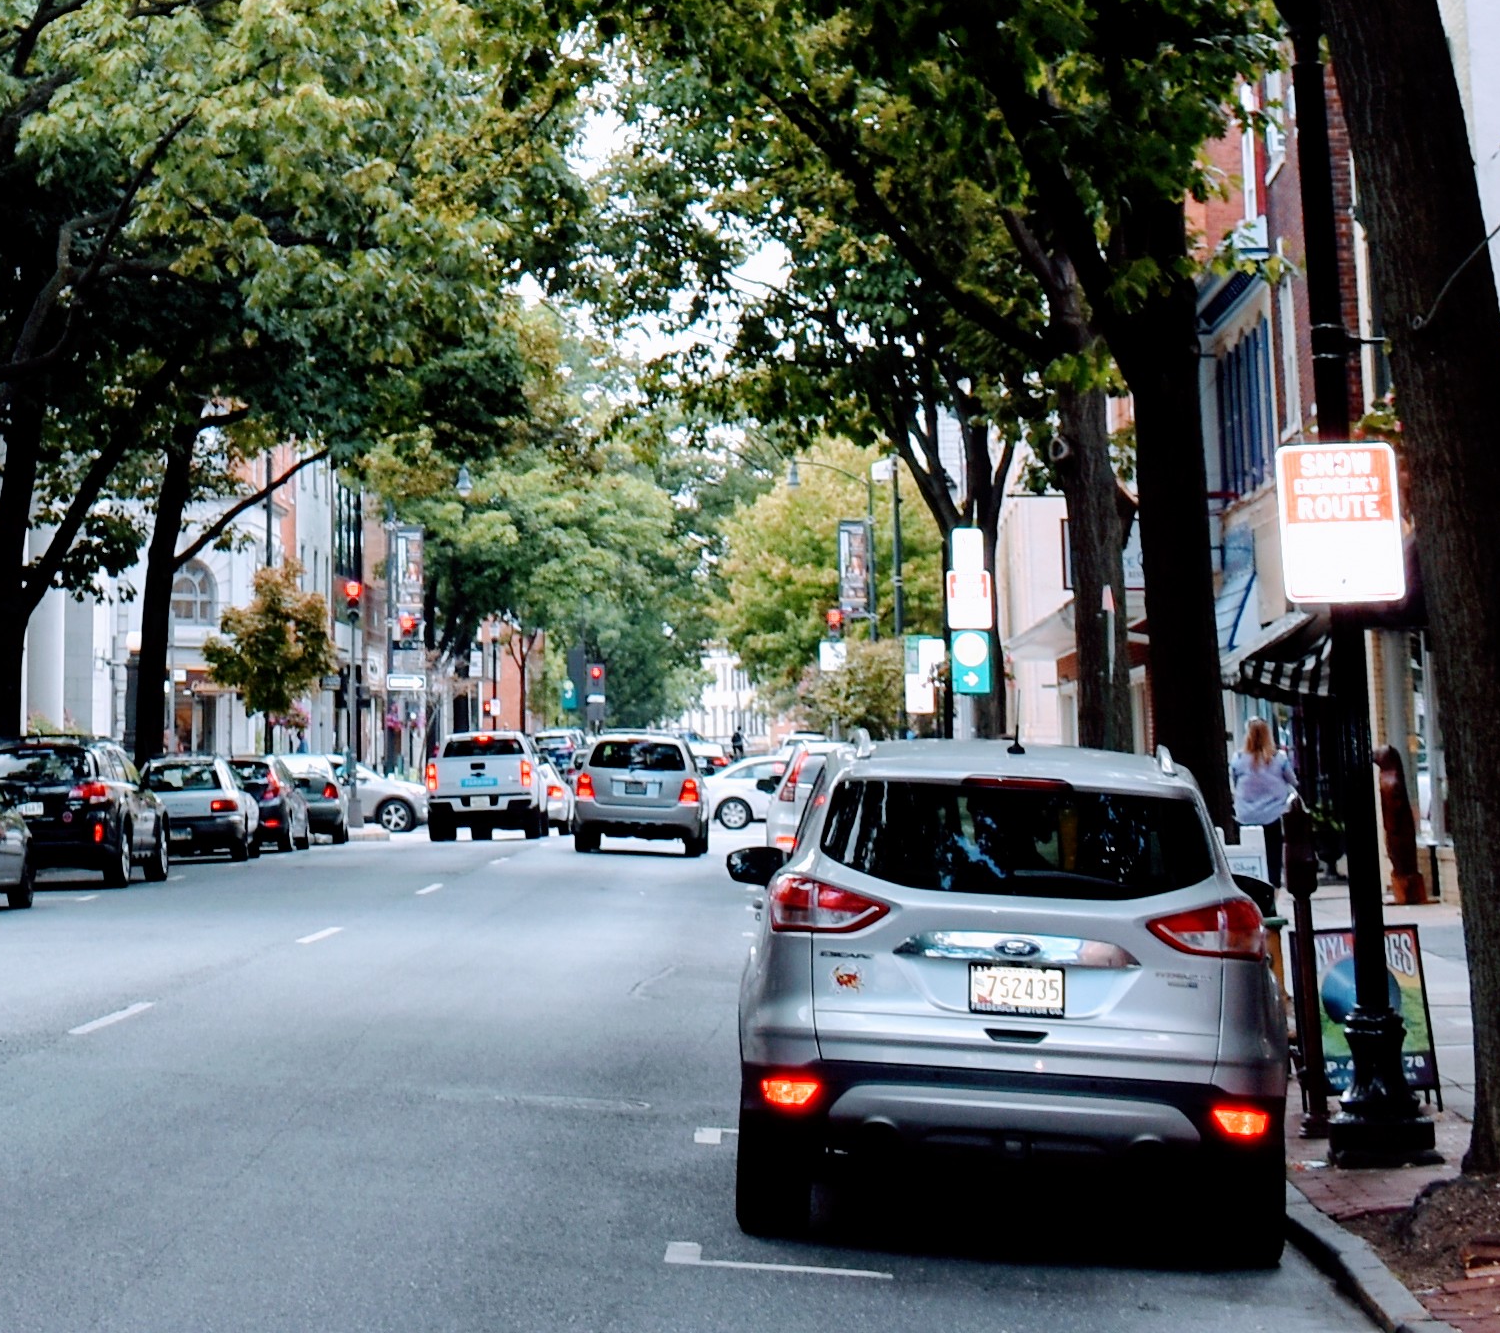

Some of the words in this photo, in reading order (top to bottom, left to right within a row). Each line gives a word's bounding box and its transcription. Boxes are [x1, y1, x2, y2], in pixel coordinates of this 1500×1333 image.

[1300, 452, 1371, 476] SNOW
[1294, 477, 1379, 494] EMERGENCY
[1298, 495, 1381, 520] ROUTE
[1315, 935, 1350, 972] NYL
[971, 1002, 1016, 1012] FREDERICK
[1018, 1005, 1046, 1014] MOTOR
